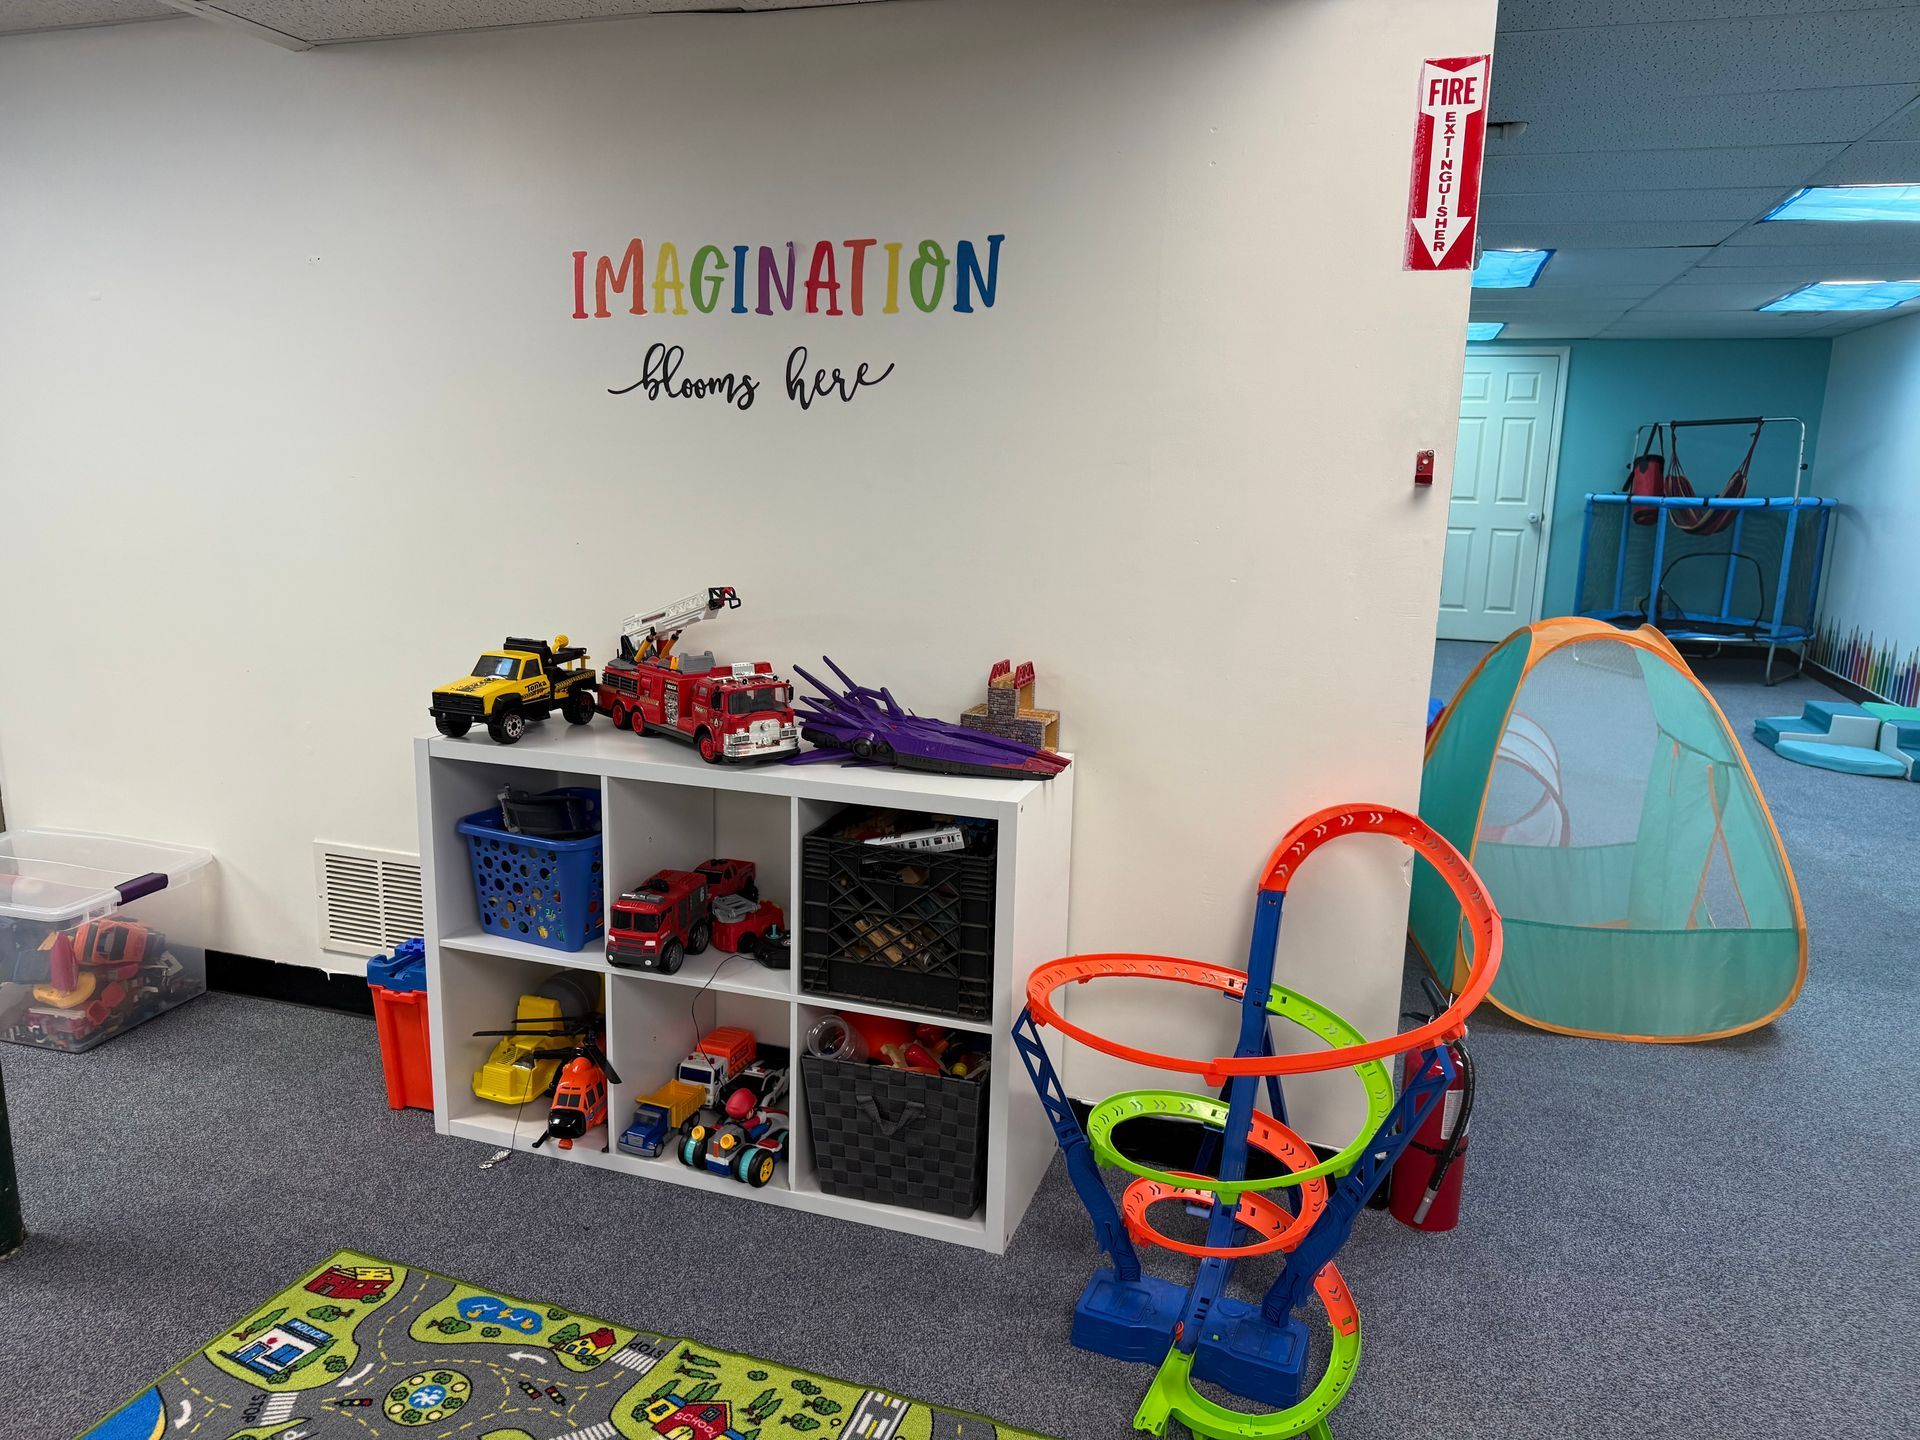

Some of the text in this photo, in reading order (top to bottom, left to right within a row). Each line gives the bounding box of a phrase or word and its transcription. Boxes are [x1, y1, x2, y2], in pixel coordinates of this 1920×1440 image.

[1428, 77, 1477, 106] FIRE
[1433, 111, 1457, 252] EXTINGUISHER
[572, 234, 1005, 319] IMAGINATION
[608, 343, 895, 410] blooms here
[525, 681, 547, 692] Tonka
[628, 1341, 665, 1359] STOP
[241, 1393, 267, 1423] STOP
[674, 1412, 718, 1438] SCHOOL
